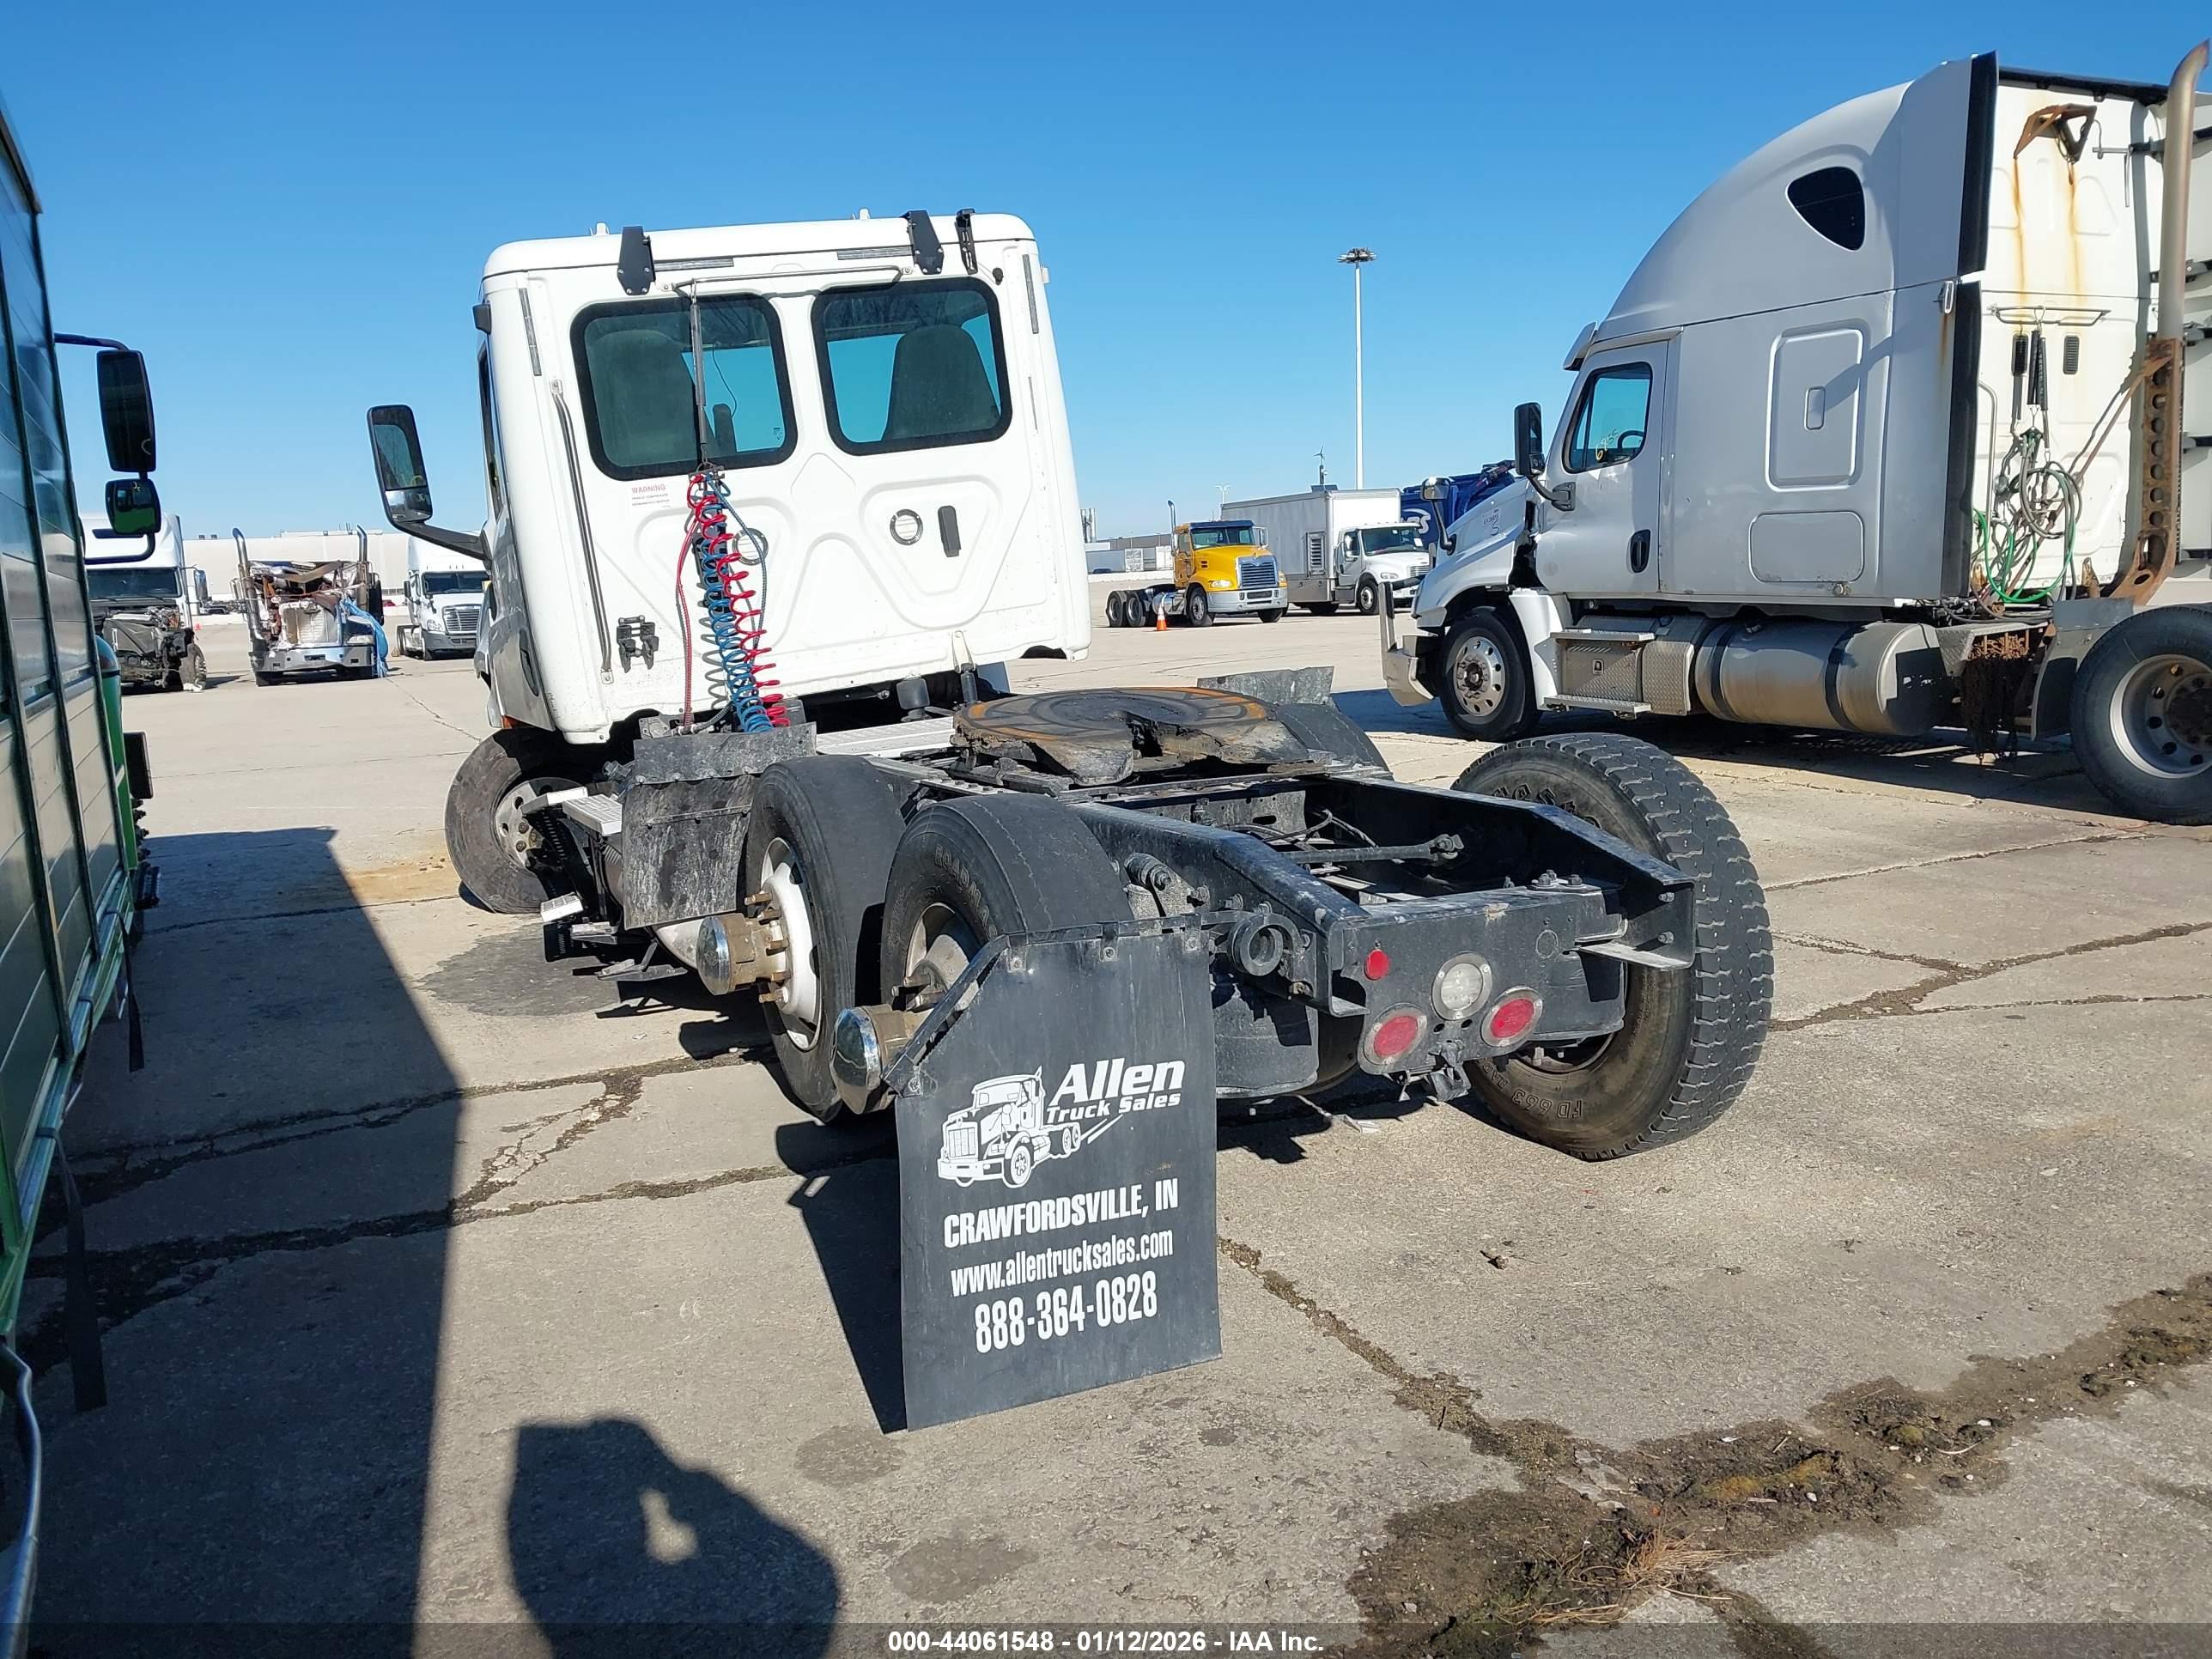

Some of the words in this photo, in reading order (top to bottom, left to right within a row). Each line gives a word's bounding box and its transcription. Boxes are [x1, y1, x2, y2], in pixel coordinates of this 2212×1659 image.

[631, 483, 666, 494] WARNING
[1048, 1057, 1185, 1107] Allen
[1511, 1087, 1553, 1116] 663
[1046, 1099, 1110, 1124] Truck
[1118, 1092, 1182, 1114] Sales
[1557, 1099, 1583, 1119] FD
[944, 1184, 1149, 1249] CRAWFORDSVILLE,
[1155, 1177, 1178, 1212] IN
[950, 1229, 1174, 1297] www.allentrucksales.com
[975, 1271, 1158, 1353] 888-364-0828
